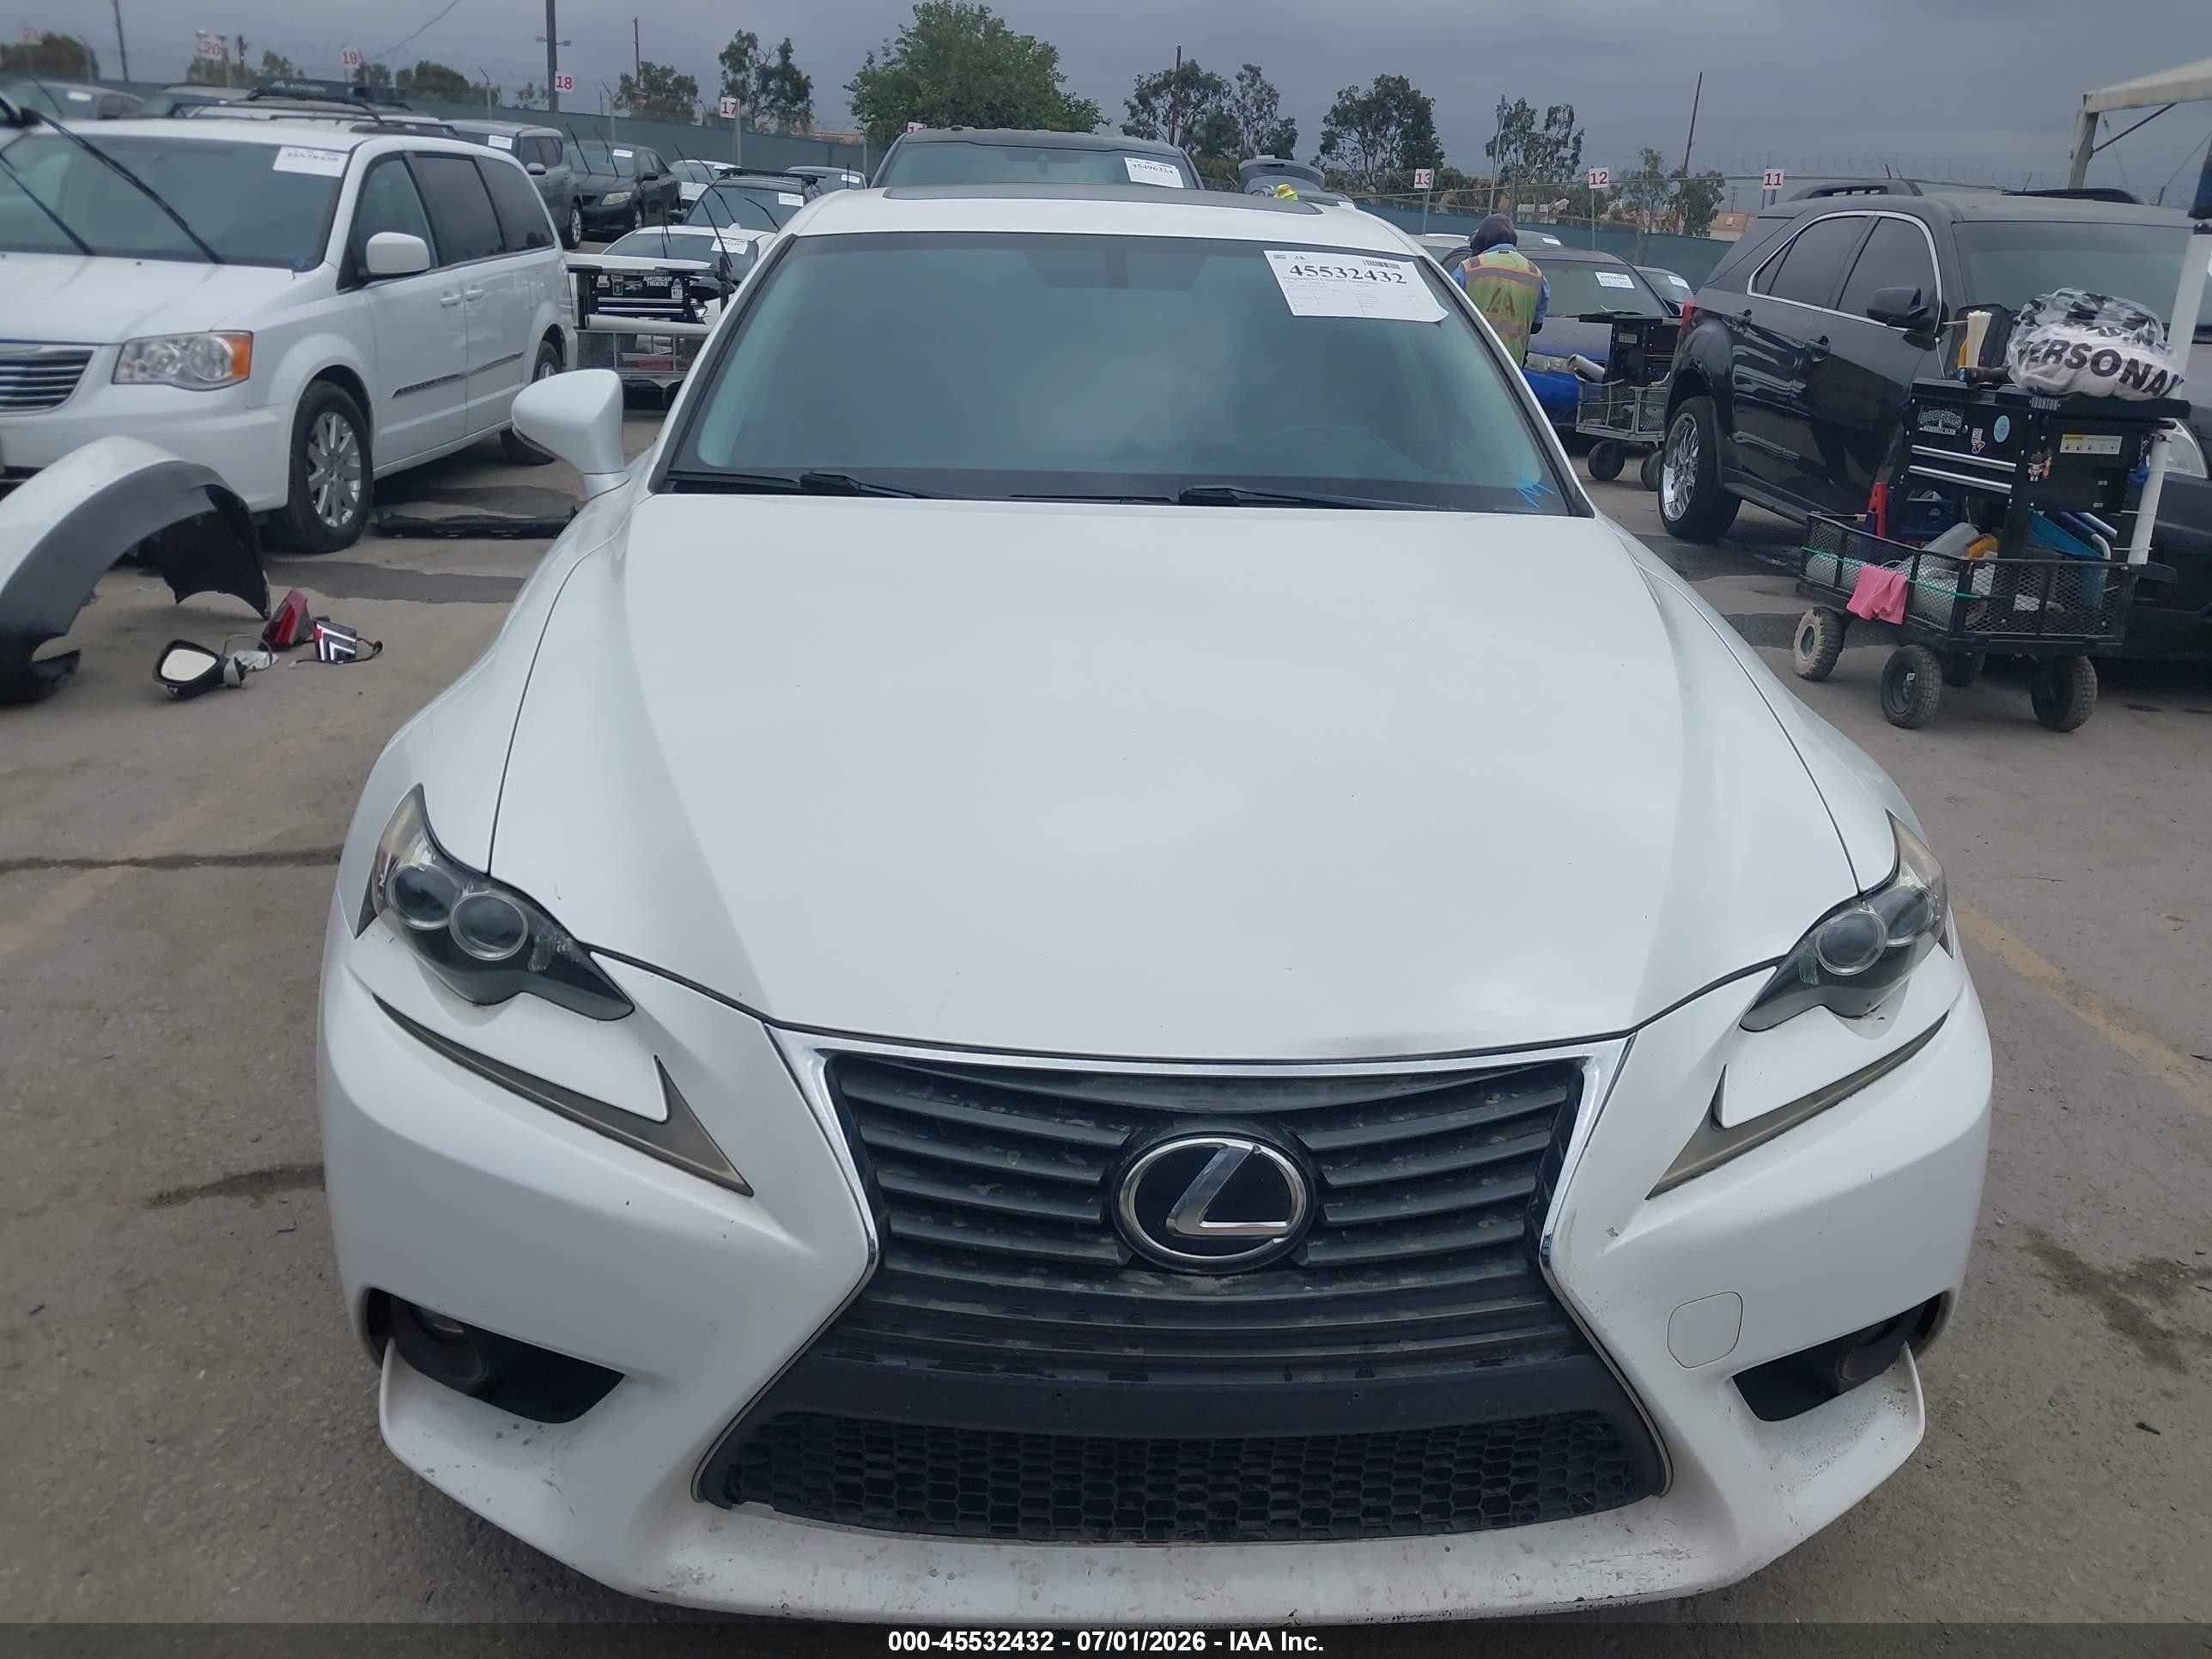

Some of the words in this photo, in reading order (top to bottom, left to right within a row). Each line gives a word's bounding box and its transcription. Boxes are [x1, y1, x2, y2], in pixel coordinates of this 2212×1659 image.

[343, 52, 357, 64] 19
[556, 76, 572, 89] 18
[721, 101, 736, 114] 17
[1415, 173, 1431, 185] 13
[1590, 172, 1607, 185] 12
[1765, 173, 1782, 185] 11
[1289, 264, 1407, 284] 45532432
